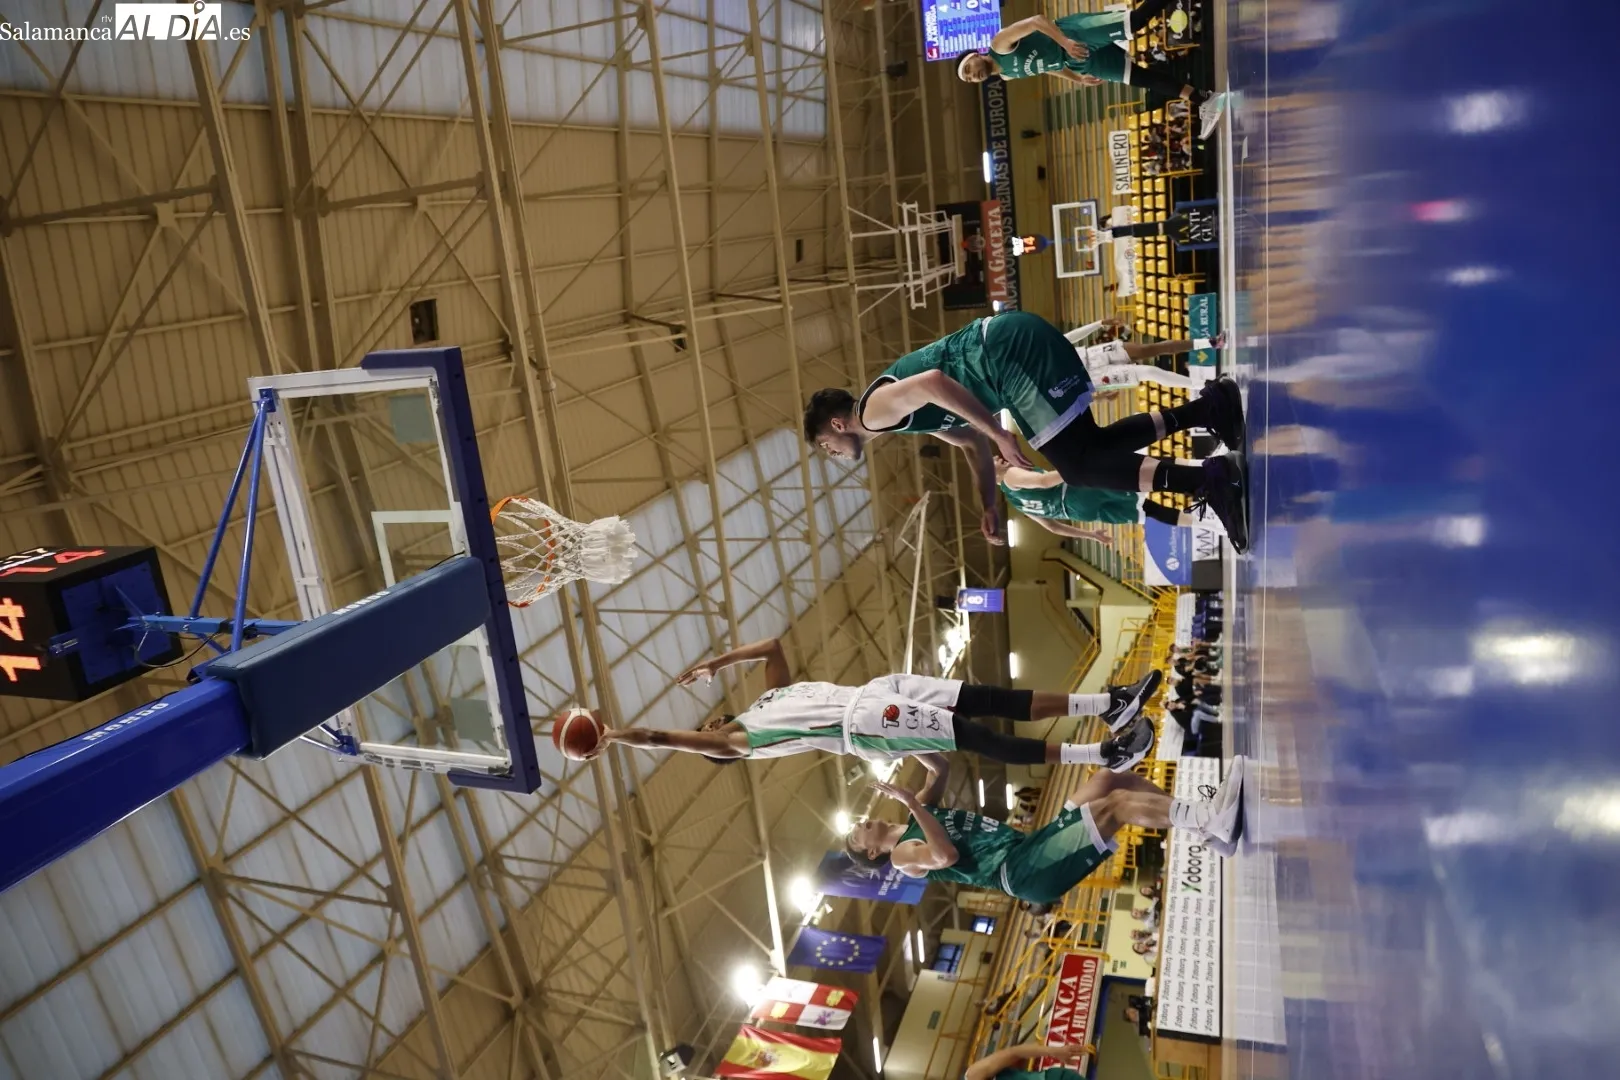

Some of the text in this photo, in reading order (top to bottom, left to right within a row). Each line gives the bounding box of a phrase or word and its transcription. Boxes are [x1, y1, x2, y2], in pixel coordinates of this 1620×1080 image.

[987, 80, 1006, 137] EUROPA
[992, 140, 1008, 160] DE
[1112, 133, 1130, 191] SALINERO
[993, 162, 1012, 213] REINAS
[988, 206, 1005, 272] GACETA
[1024, 236, 1036, 253] 14
[1200, 296, 1208, 325] RURAL
[967, 595, 984, 605] 8
[0, 597, 42, 682] 14
[82, 702, 170, 740] MONDO
[1071, 959, 1096, 1029] HUMANIDAD
